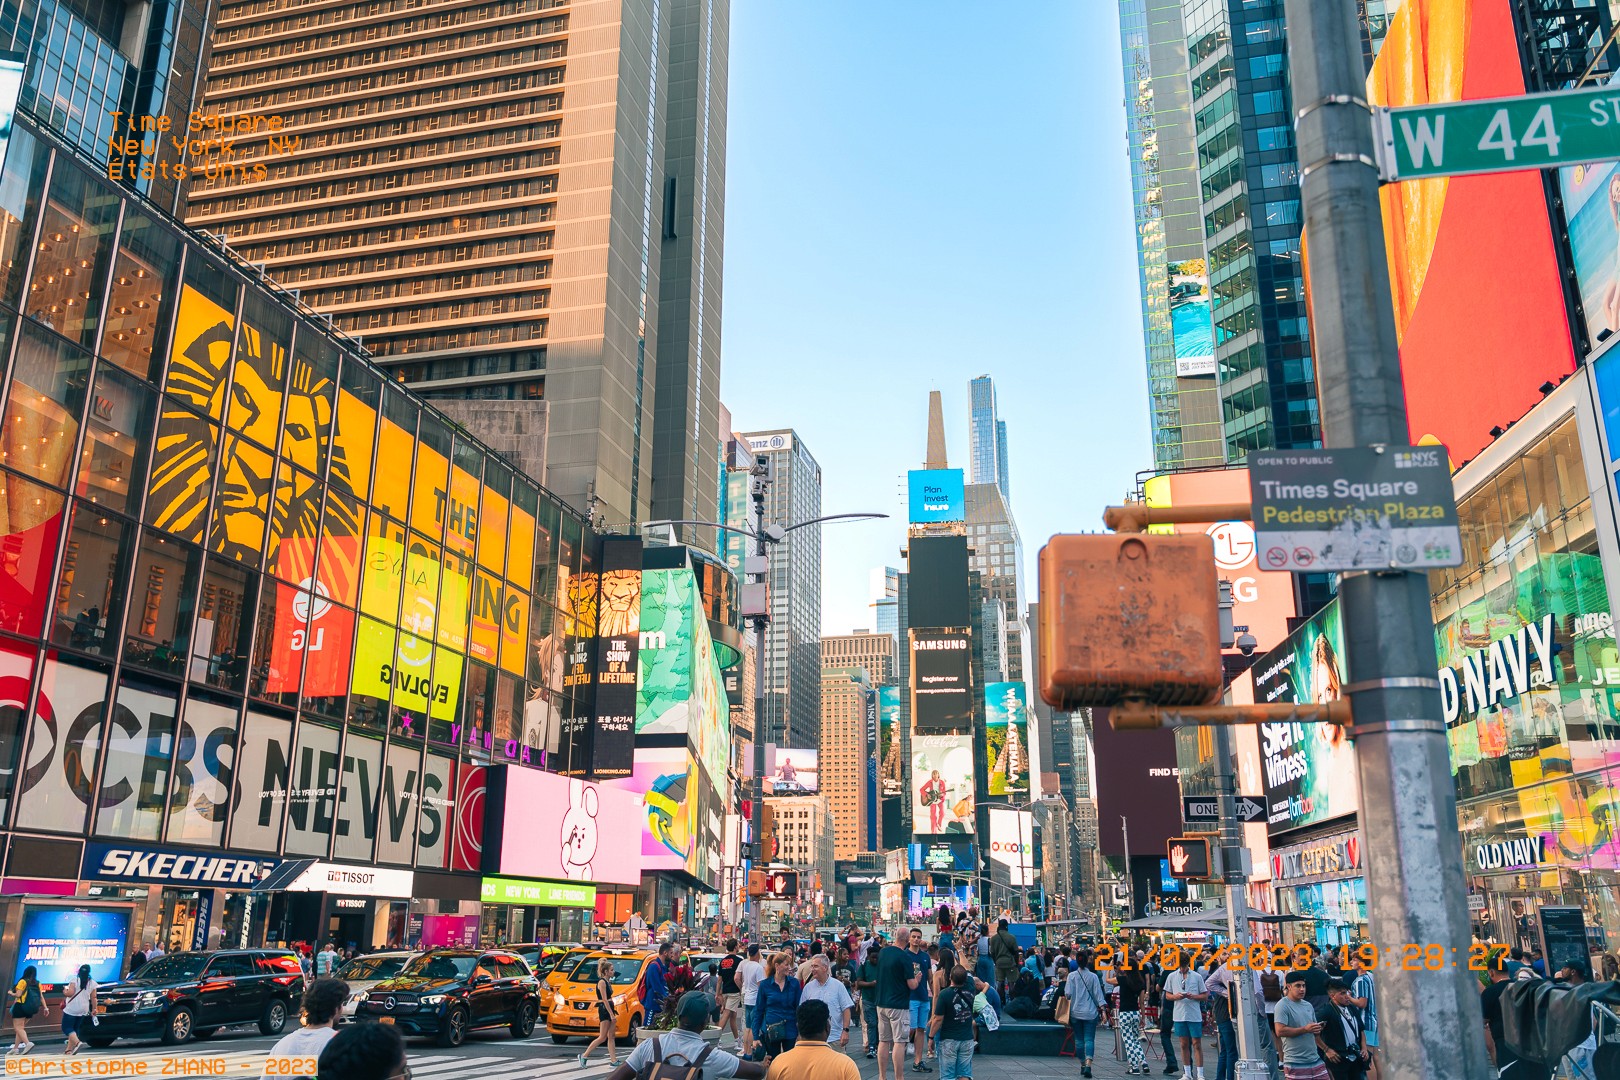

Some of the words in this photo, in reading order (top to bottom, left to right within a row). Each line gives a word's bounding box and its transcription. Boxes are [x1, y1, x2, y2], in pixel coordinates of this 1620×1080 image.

[1398, 114, 1445, 168] W
[1477, 104, 1561, 161] 44
[1257, 458, 1284, 466] OPEN
[1299, 456, 1333, 465] PUBLIC
[1412, 451, 1439, 461] NYC
[1259, 479, 1329, 499] Times
[1333, 478, 1418, 501] Square
[924, 494, 949, 502] Invest
[433, 487, 476, 541] THE
[1263, 503, 1380, 524] Pedestrian
[1383, 501, 1445, 520] Plaza
[440, 630, 449, 640] ON
[470, 639, 487, 655] STREET
[611, 640, 627, 651] THE
[912, 640, 967, 650] SAMSUNG
[606, 651, 631, 662] SHOW
[609, 662, 620, 673] OF
[620, 662, 627, 672] A
[1463, 613, 1556, 714] NAVY
[599, 673, 636, 684] LIFETIME
[922, 735, 959, 748] Coca-Cola
[62, 700, 248, 822] CBS
[258, 738, 443, 848] NEWS
[1149, 768, 1171, 777] FIND
[1265, 749, 1308, 789] Witness
[1195, 804, 1219, 815] ONE
[1301, 843, 1340, 876] GIFTS
[1476, 843, 1502, 870] OLD
[1502, 836, 1543, 867] NAVY
[98, 849, 275, 884] SKECHERS
[342, 871, 375, 884] TISSOT
[505, 884, 522, 899] NEW
[523, 886, 541, 899] YORK
[548, 888, 562, 900] LINE
[563, 889, 585, 901] FRIENDS
[345, 899, 367, 908] TISSOT
